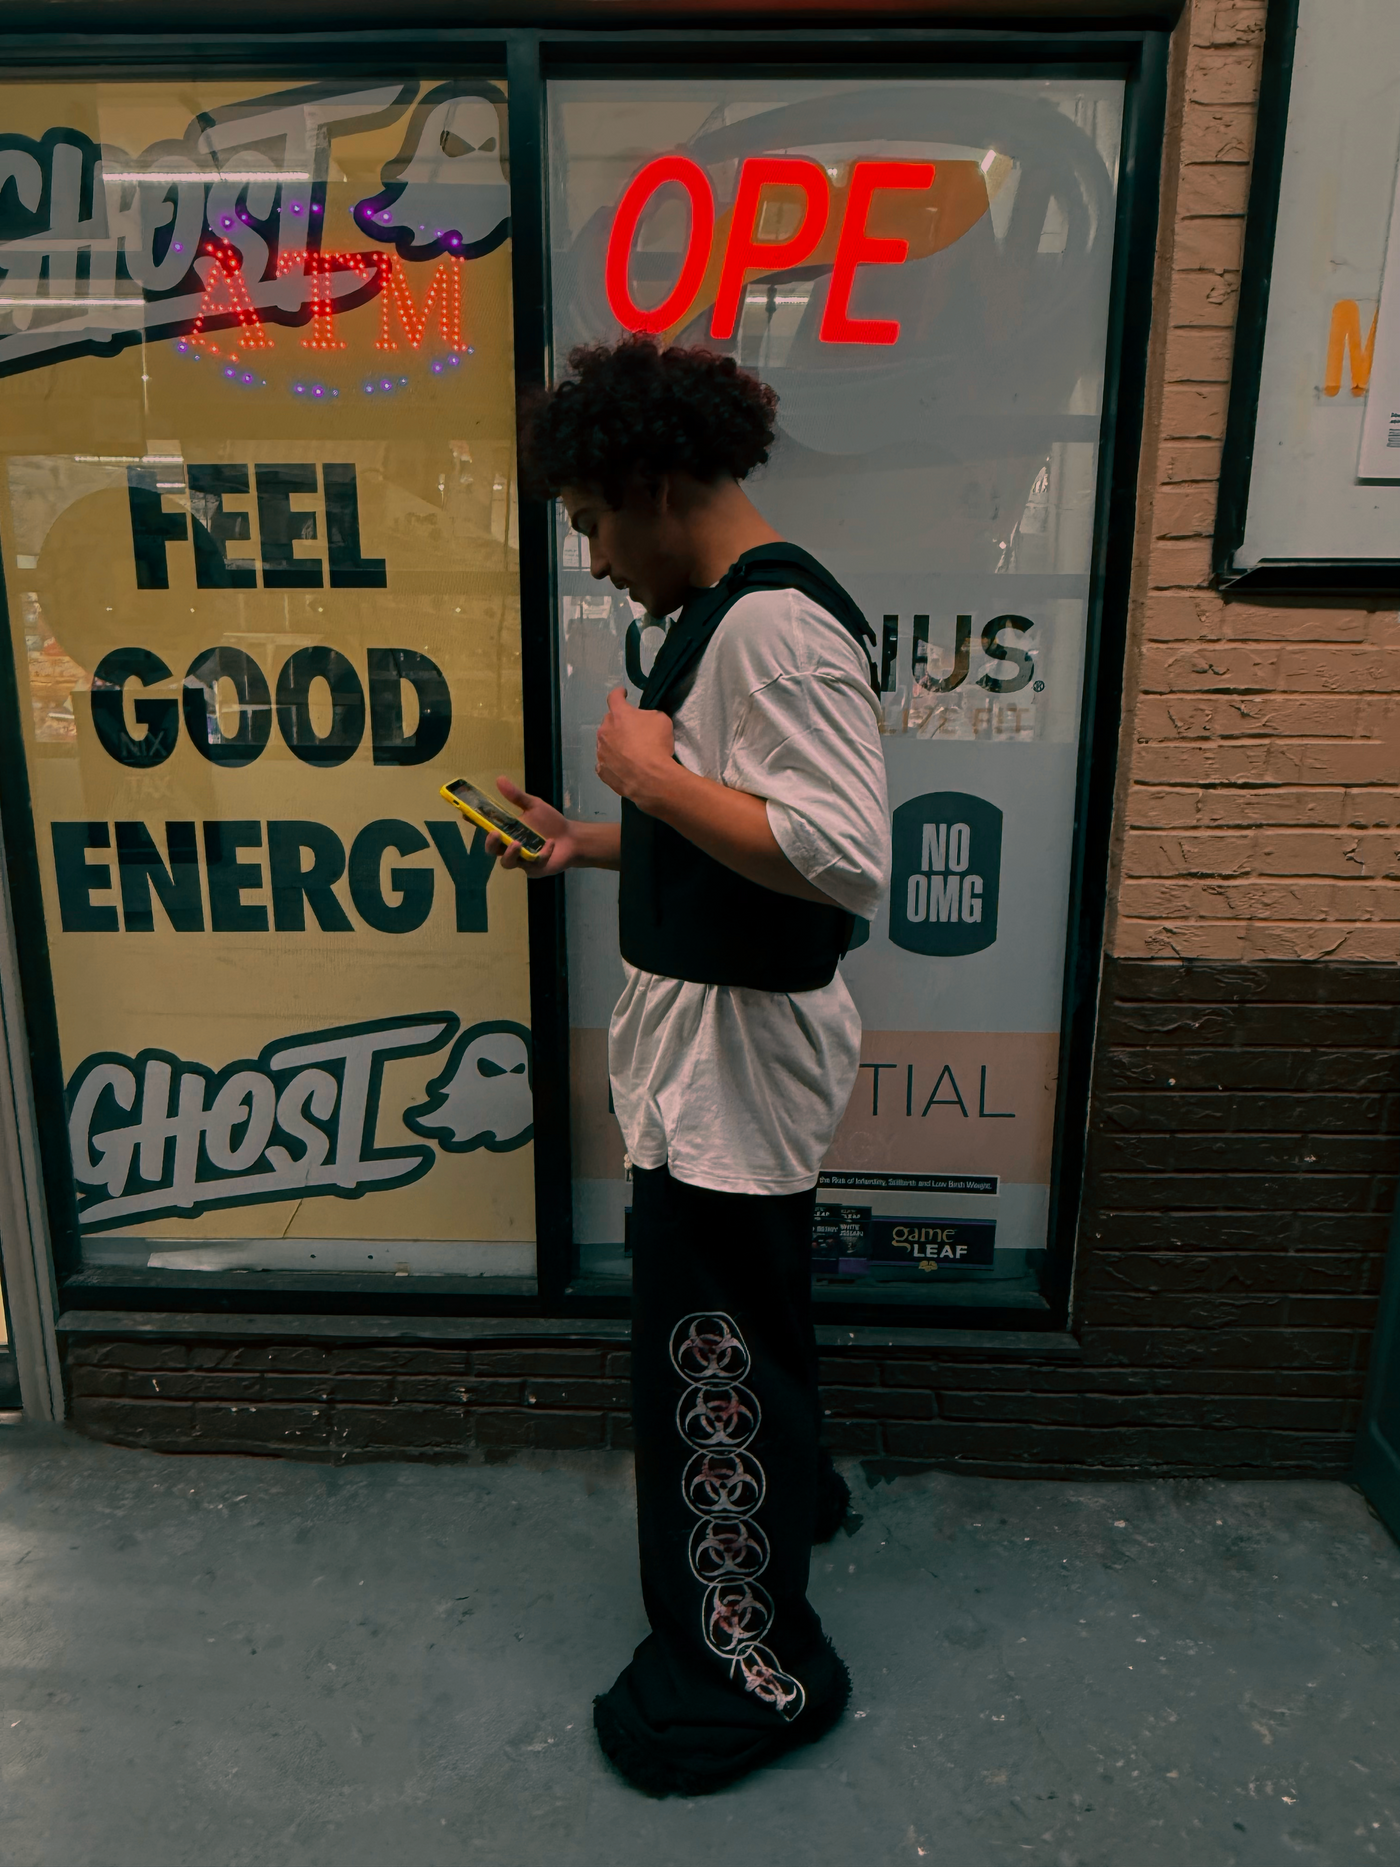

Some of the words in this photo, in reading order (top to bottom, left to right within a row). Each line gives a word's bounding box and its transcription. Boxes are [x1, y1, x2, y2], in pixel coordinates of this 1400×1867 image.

[180, 238, 469, 354] ATM
[127, 463, 388, 589] FEEL
[90, 646, 453, 769] GOOD
[50, 818, 499, 934] ENERGY
[907, 874, 984, 924] OMG
[921, 822, 970, 873] NO
[68, 1012, 458, 1231] GHOST
[891, 1225, 956, 1253] game
[913, 1244, 968, 1259] LEAF
